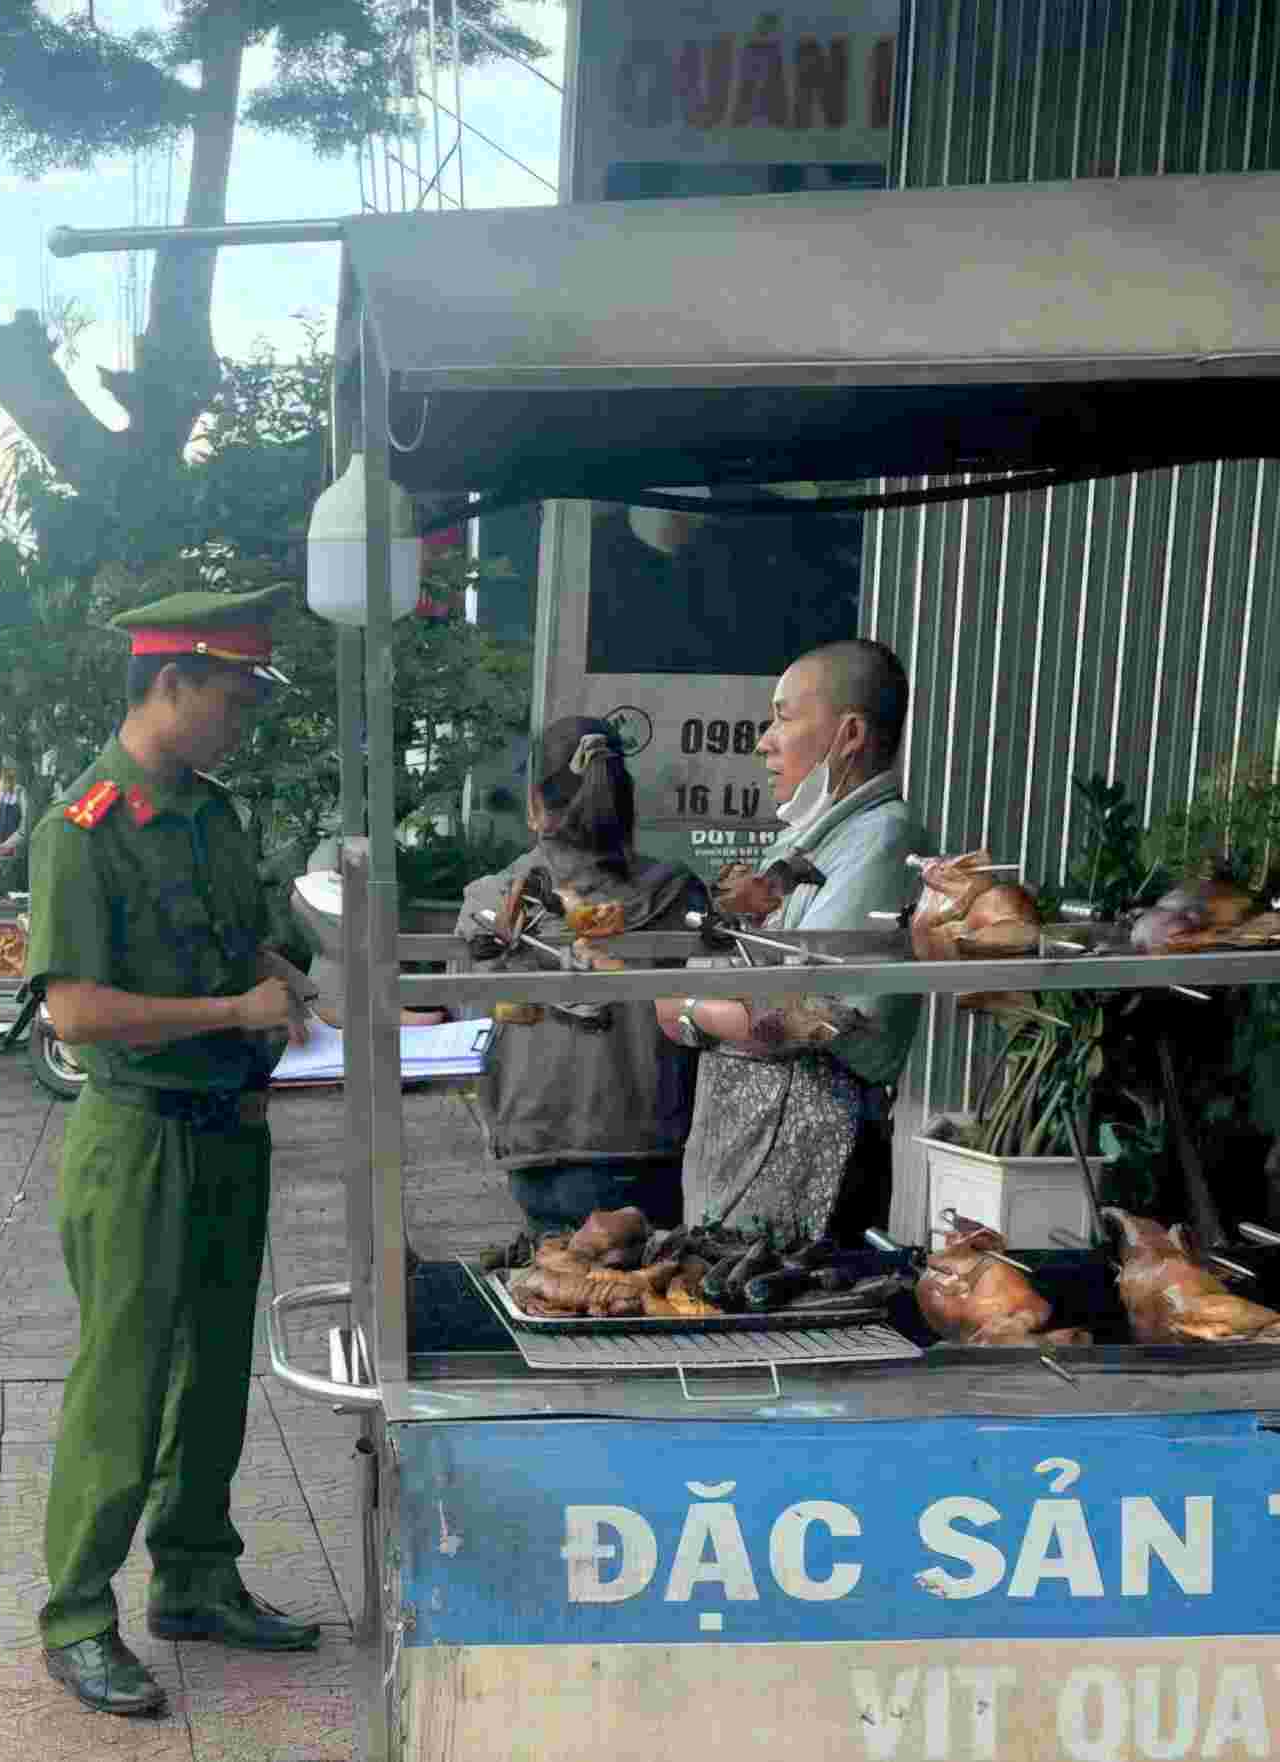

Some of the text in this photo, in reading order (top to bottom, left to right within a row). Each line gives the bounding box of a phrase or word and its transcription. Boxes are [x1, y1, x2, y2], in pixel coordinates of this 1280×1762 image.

[675, 784, 710, 815] 16
[561, 1456, 1215, 1632] ĐẶC SẢN
[1056, 1663, 1280, 1761] QUA
